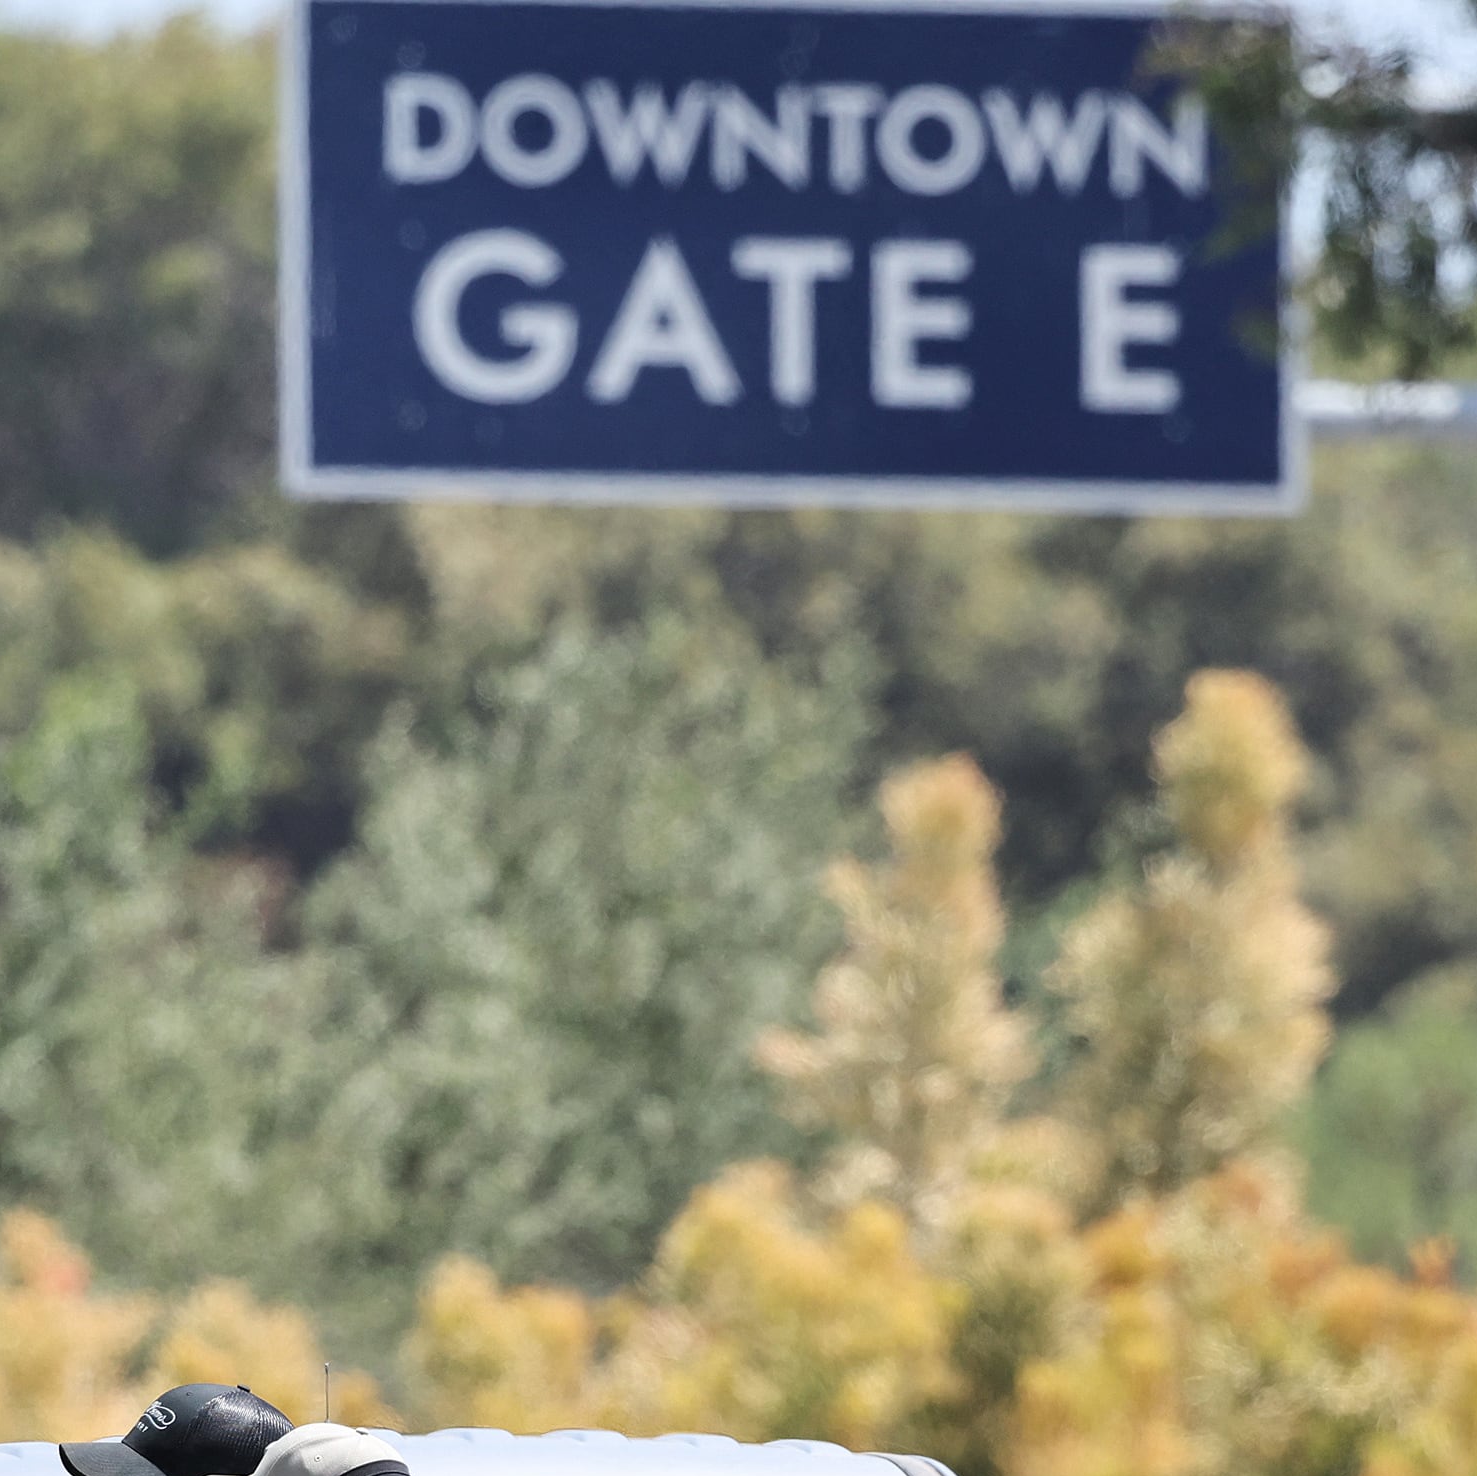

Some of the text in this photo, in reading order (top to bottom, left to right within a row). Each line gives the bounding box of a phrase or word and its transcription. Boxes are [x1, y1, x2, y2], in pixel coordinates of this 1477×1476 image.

[382, 72, 1208, 194] DOWNTOWN
[412, 228, 1181, 413] GATE E
